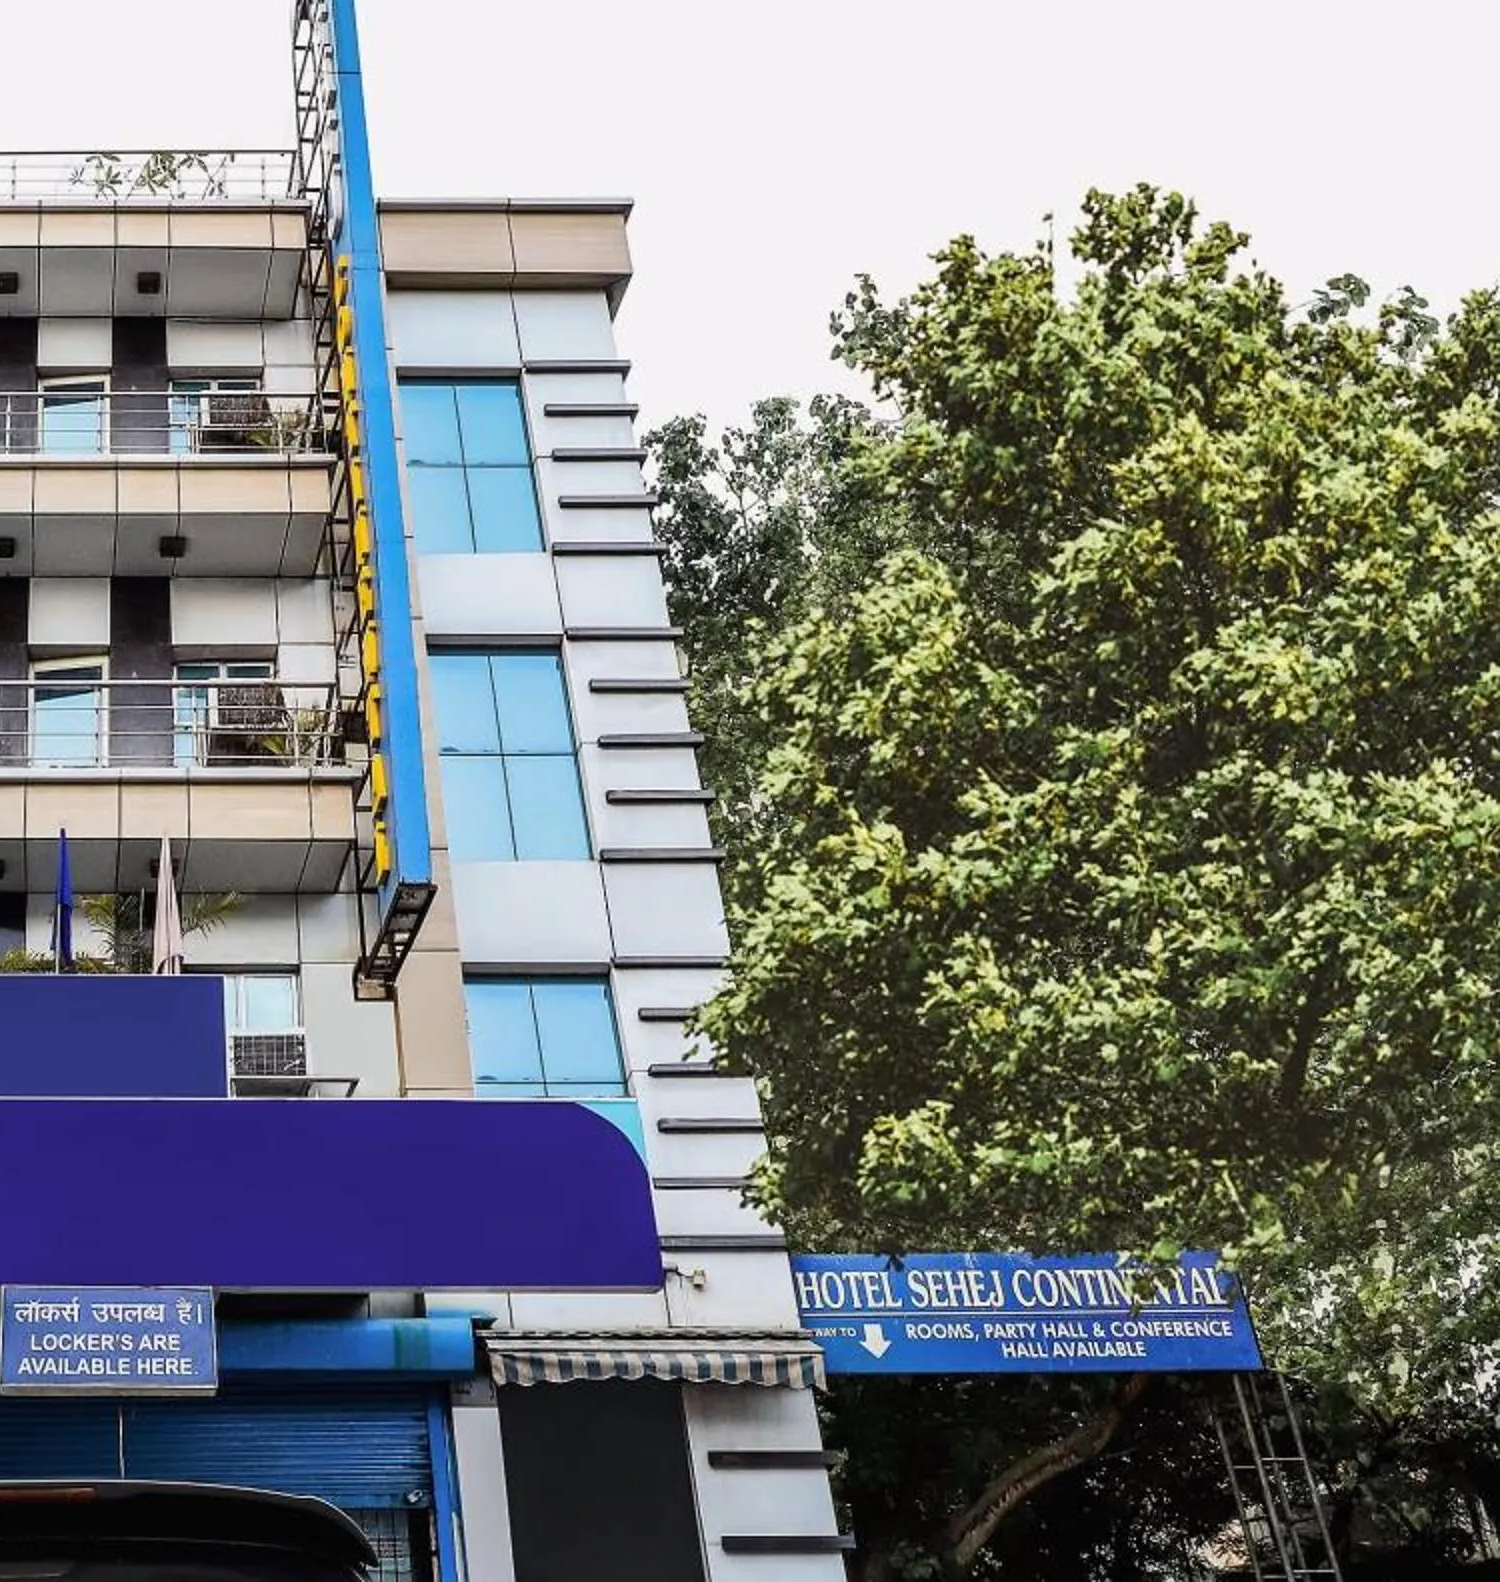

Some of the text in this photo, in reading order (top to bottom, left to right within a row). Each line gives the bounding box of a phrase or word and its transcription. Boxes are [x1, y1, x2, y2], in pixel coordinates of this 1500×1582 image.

[795, 1271, 902, 1309] HOTEL
[907, 1269, 1004, 1308] SEHEJ
[13, 1297, 80, 1323] लॉकर्स
[91, 1302, 165, 1323] उपलब्ध
[839, 1327, 857, 1338] TO
[905, 1320, 1233, 1342] ROOMS, PARTY HALL & CONFERENCE
[31, 1333, 181, 1351] LOCKER'S ARE
[1002, 1341, 1147, 1359] HALL AVAILABLE
[17, 1357, 200, 1375] AVAILABLE HERE.
